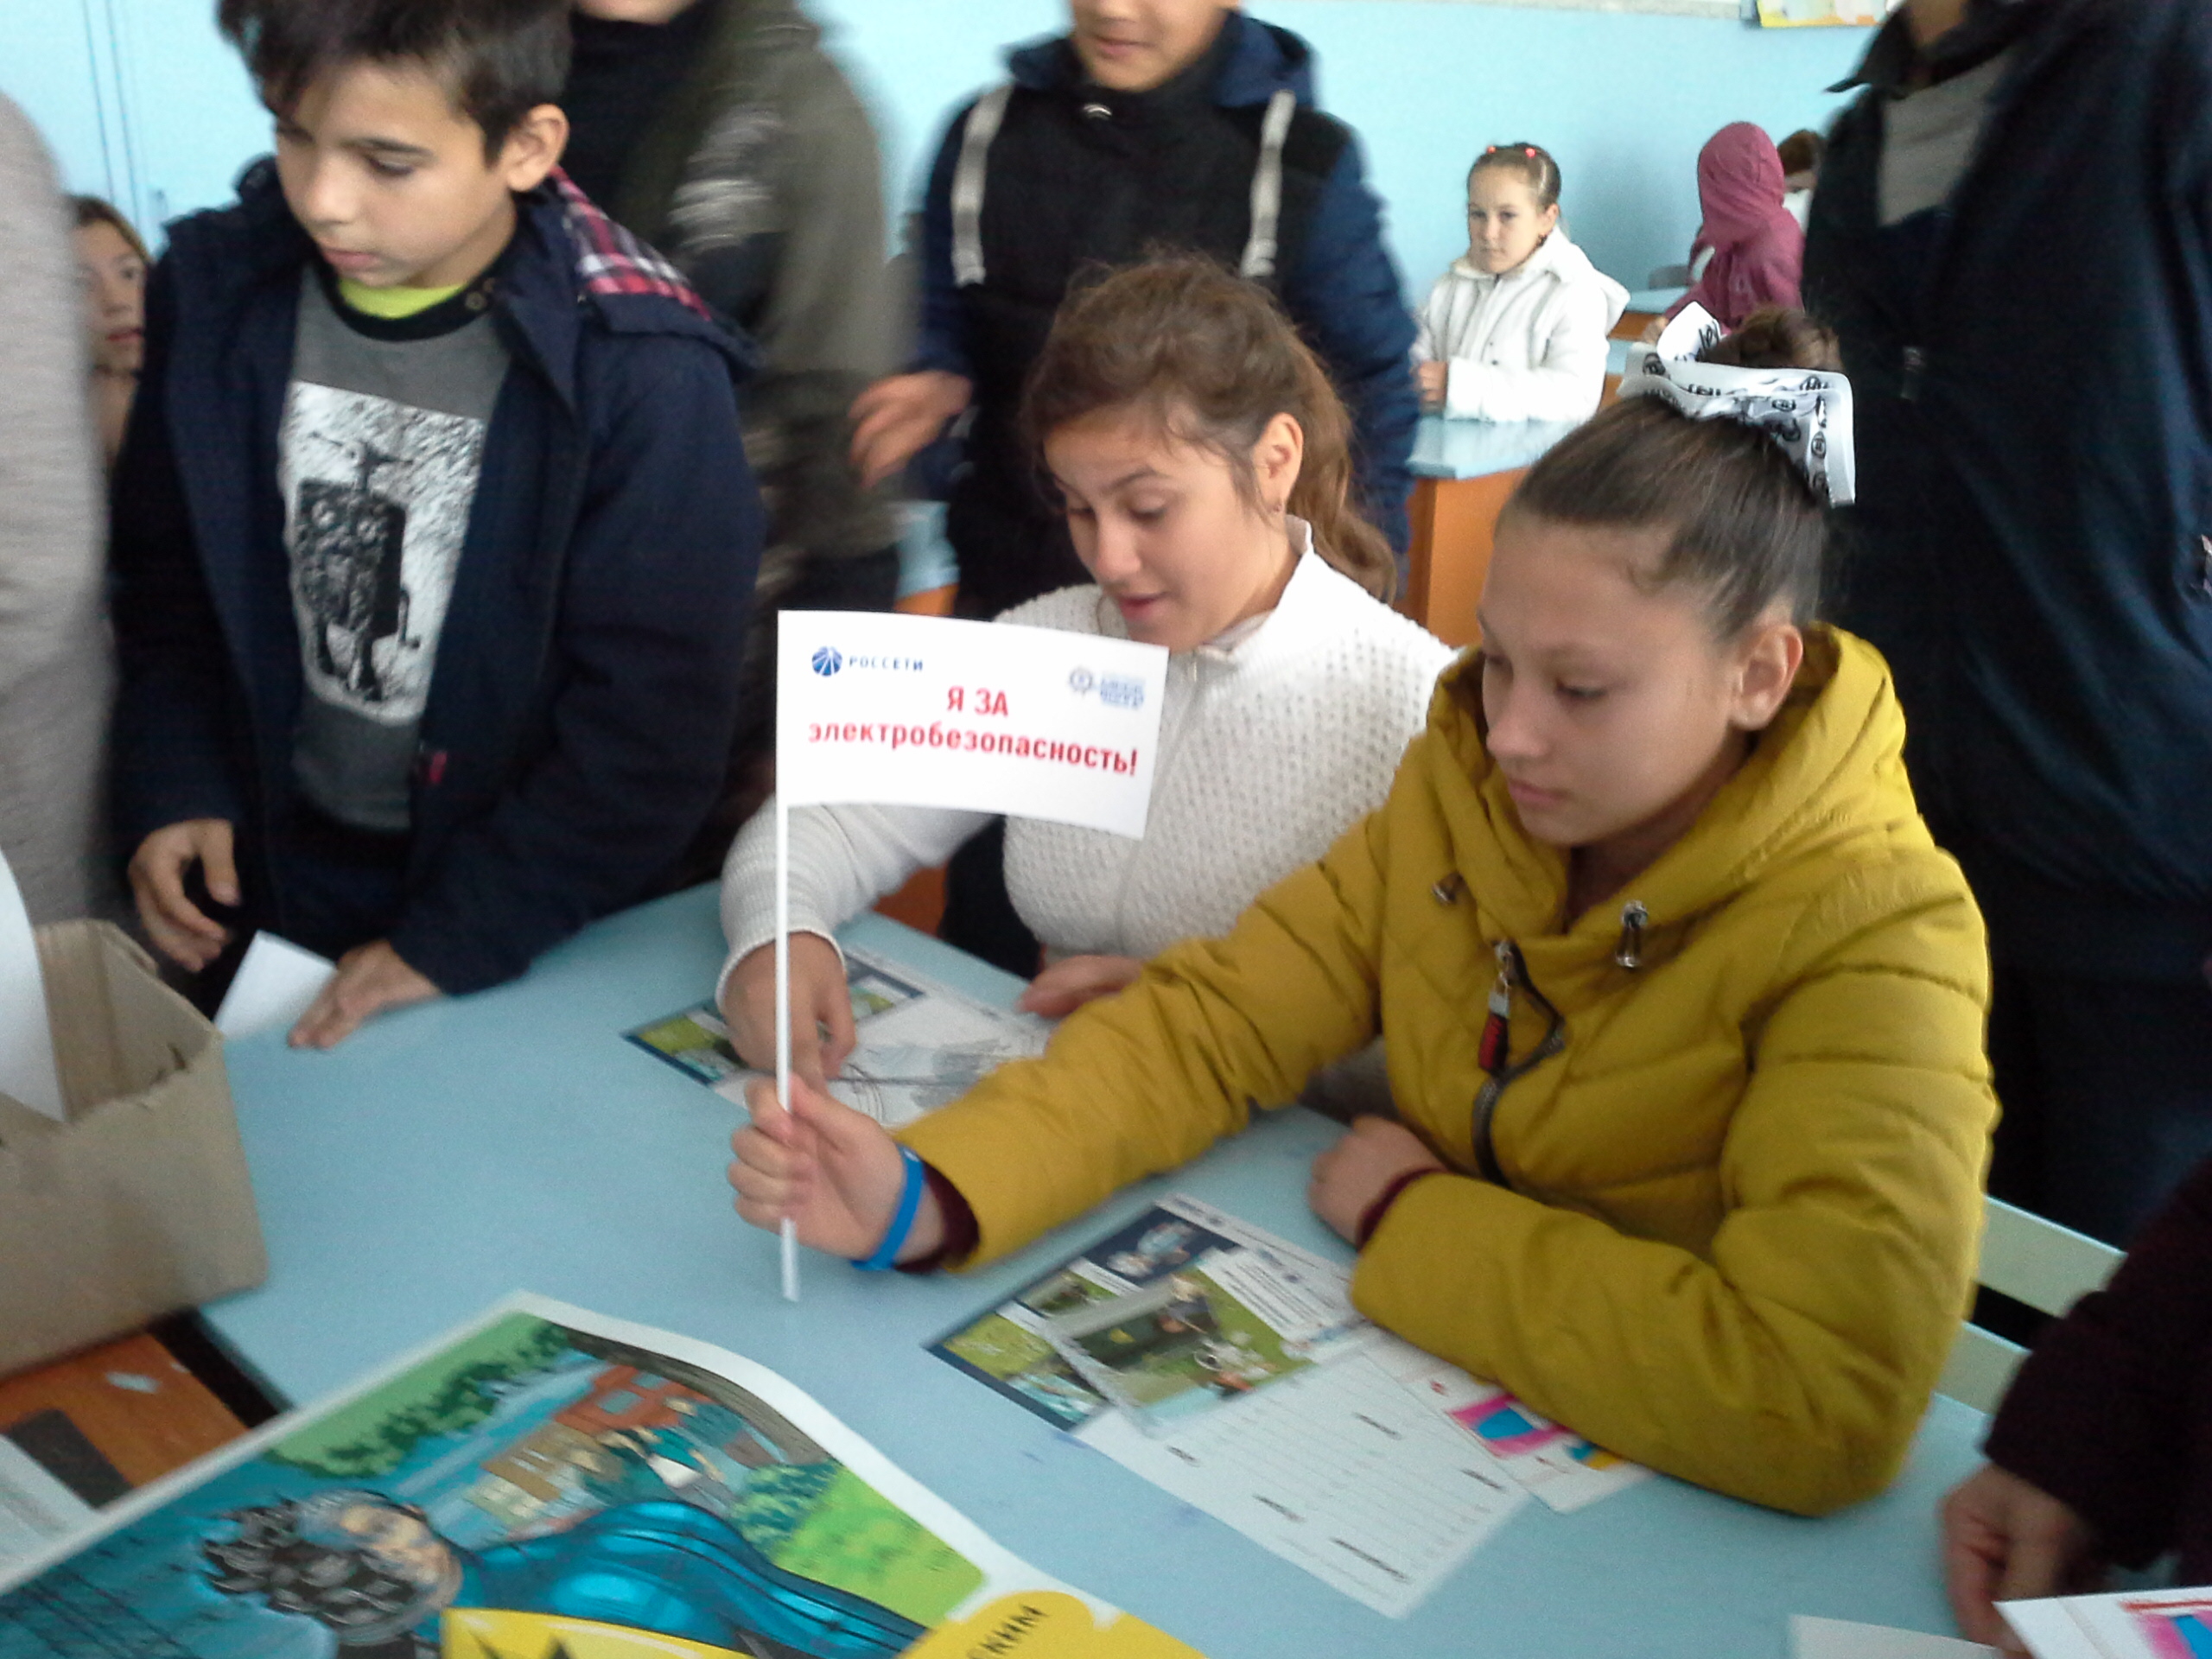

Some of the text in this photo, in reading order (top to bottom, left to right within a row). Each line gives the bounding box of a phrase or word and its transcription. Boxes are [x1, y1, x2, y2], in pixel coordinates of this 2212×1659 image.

[849, 655, 924, 672] РОССЕТИ
[947, 685, 1009, 717] Я ЗА
[809, 720, 1138, 775] электробезопасность!
